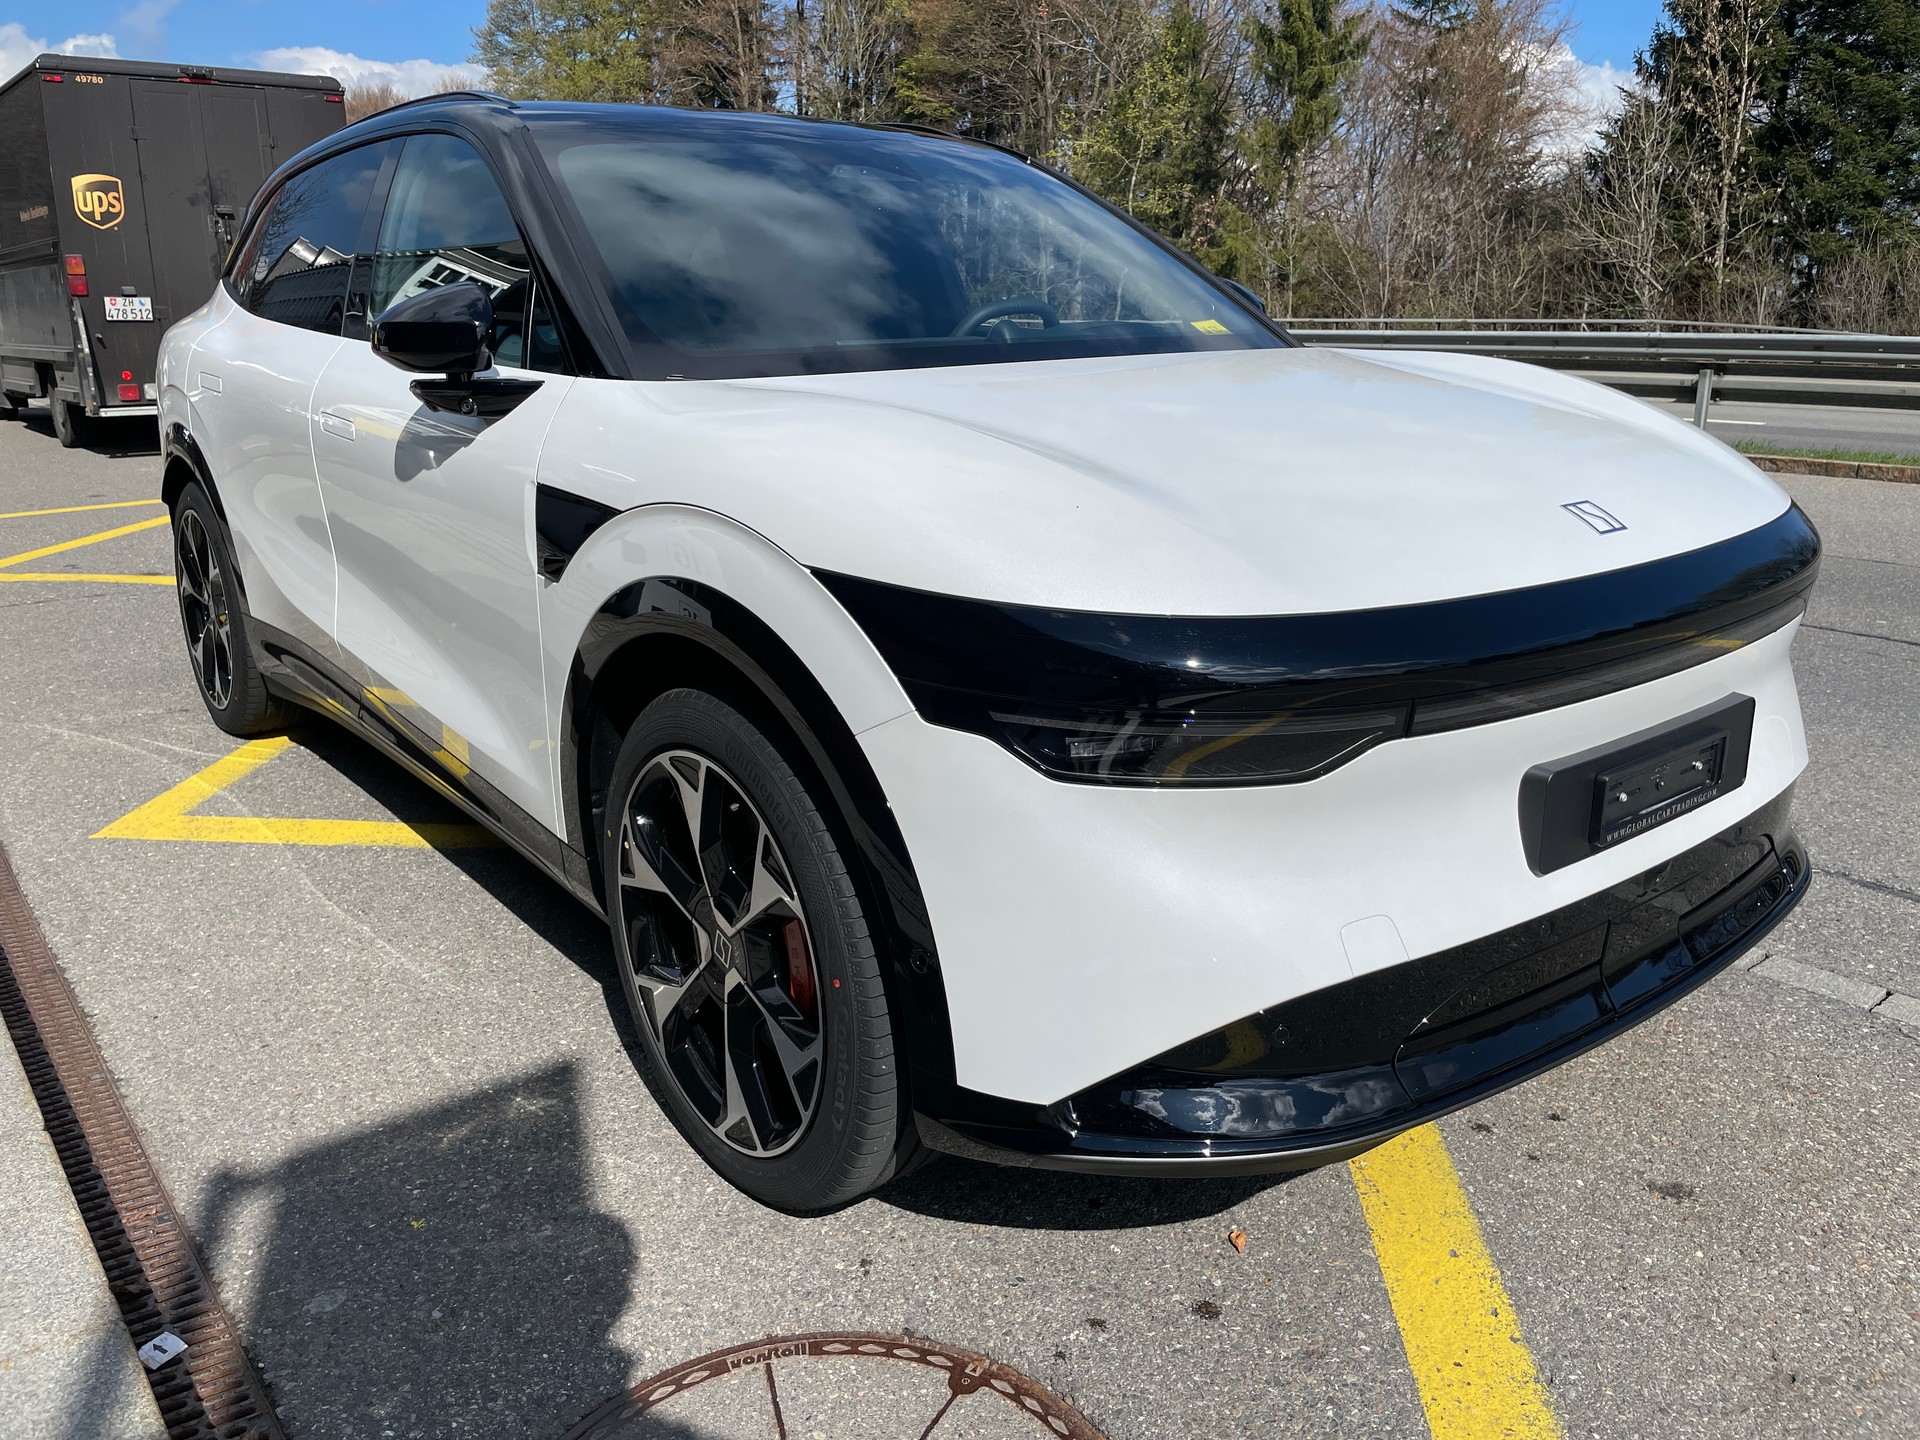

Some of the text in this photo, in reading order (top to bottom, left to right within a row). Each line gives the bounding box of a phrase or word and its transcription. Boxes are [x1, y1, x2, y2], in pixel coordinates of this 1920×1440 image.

[75, 75, 104, 84] 49780
[76, 190, 121, 221] ups
[122, 298, 135, 307] ZH
[724, 741, 792, 833] Continental
